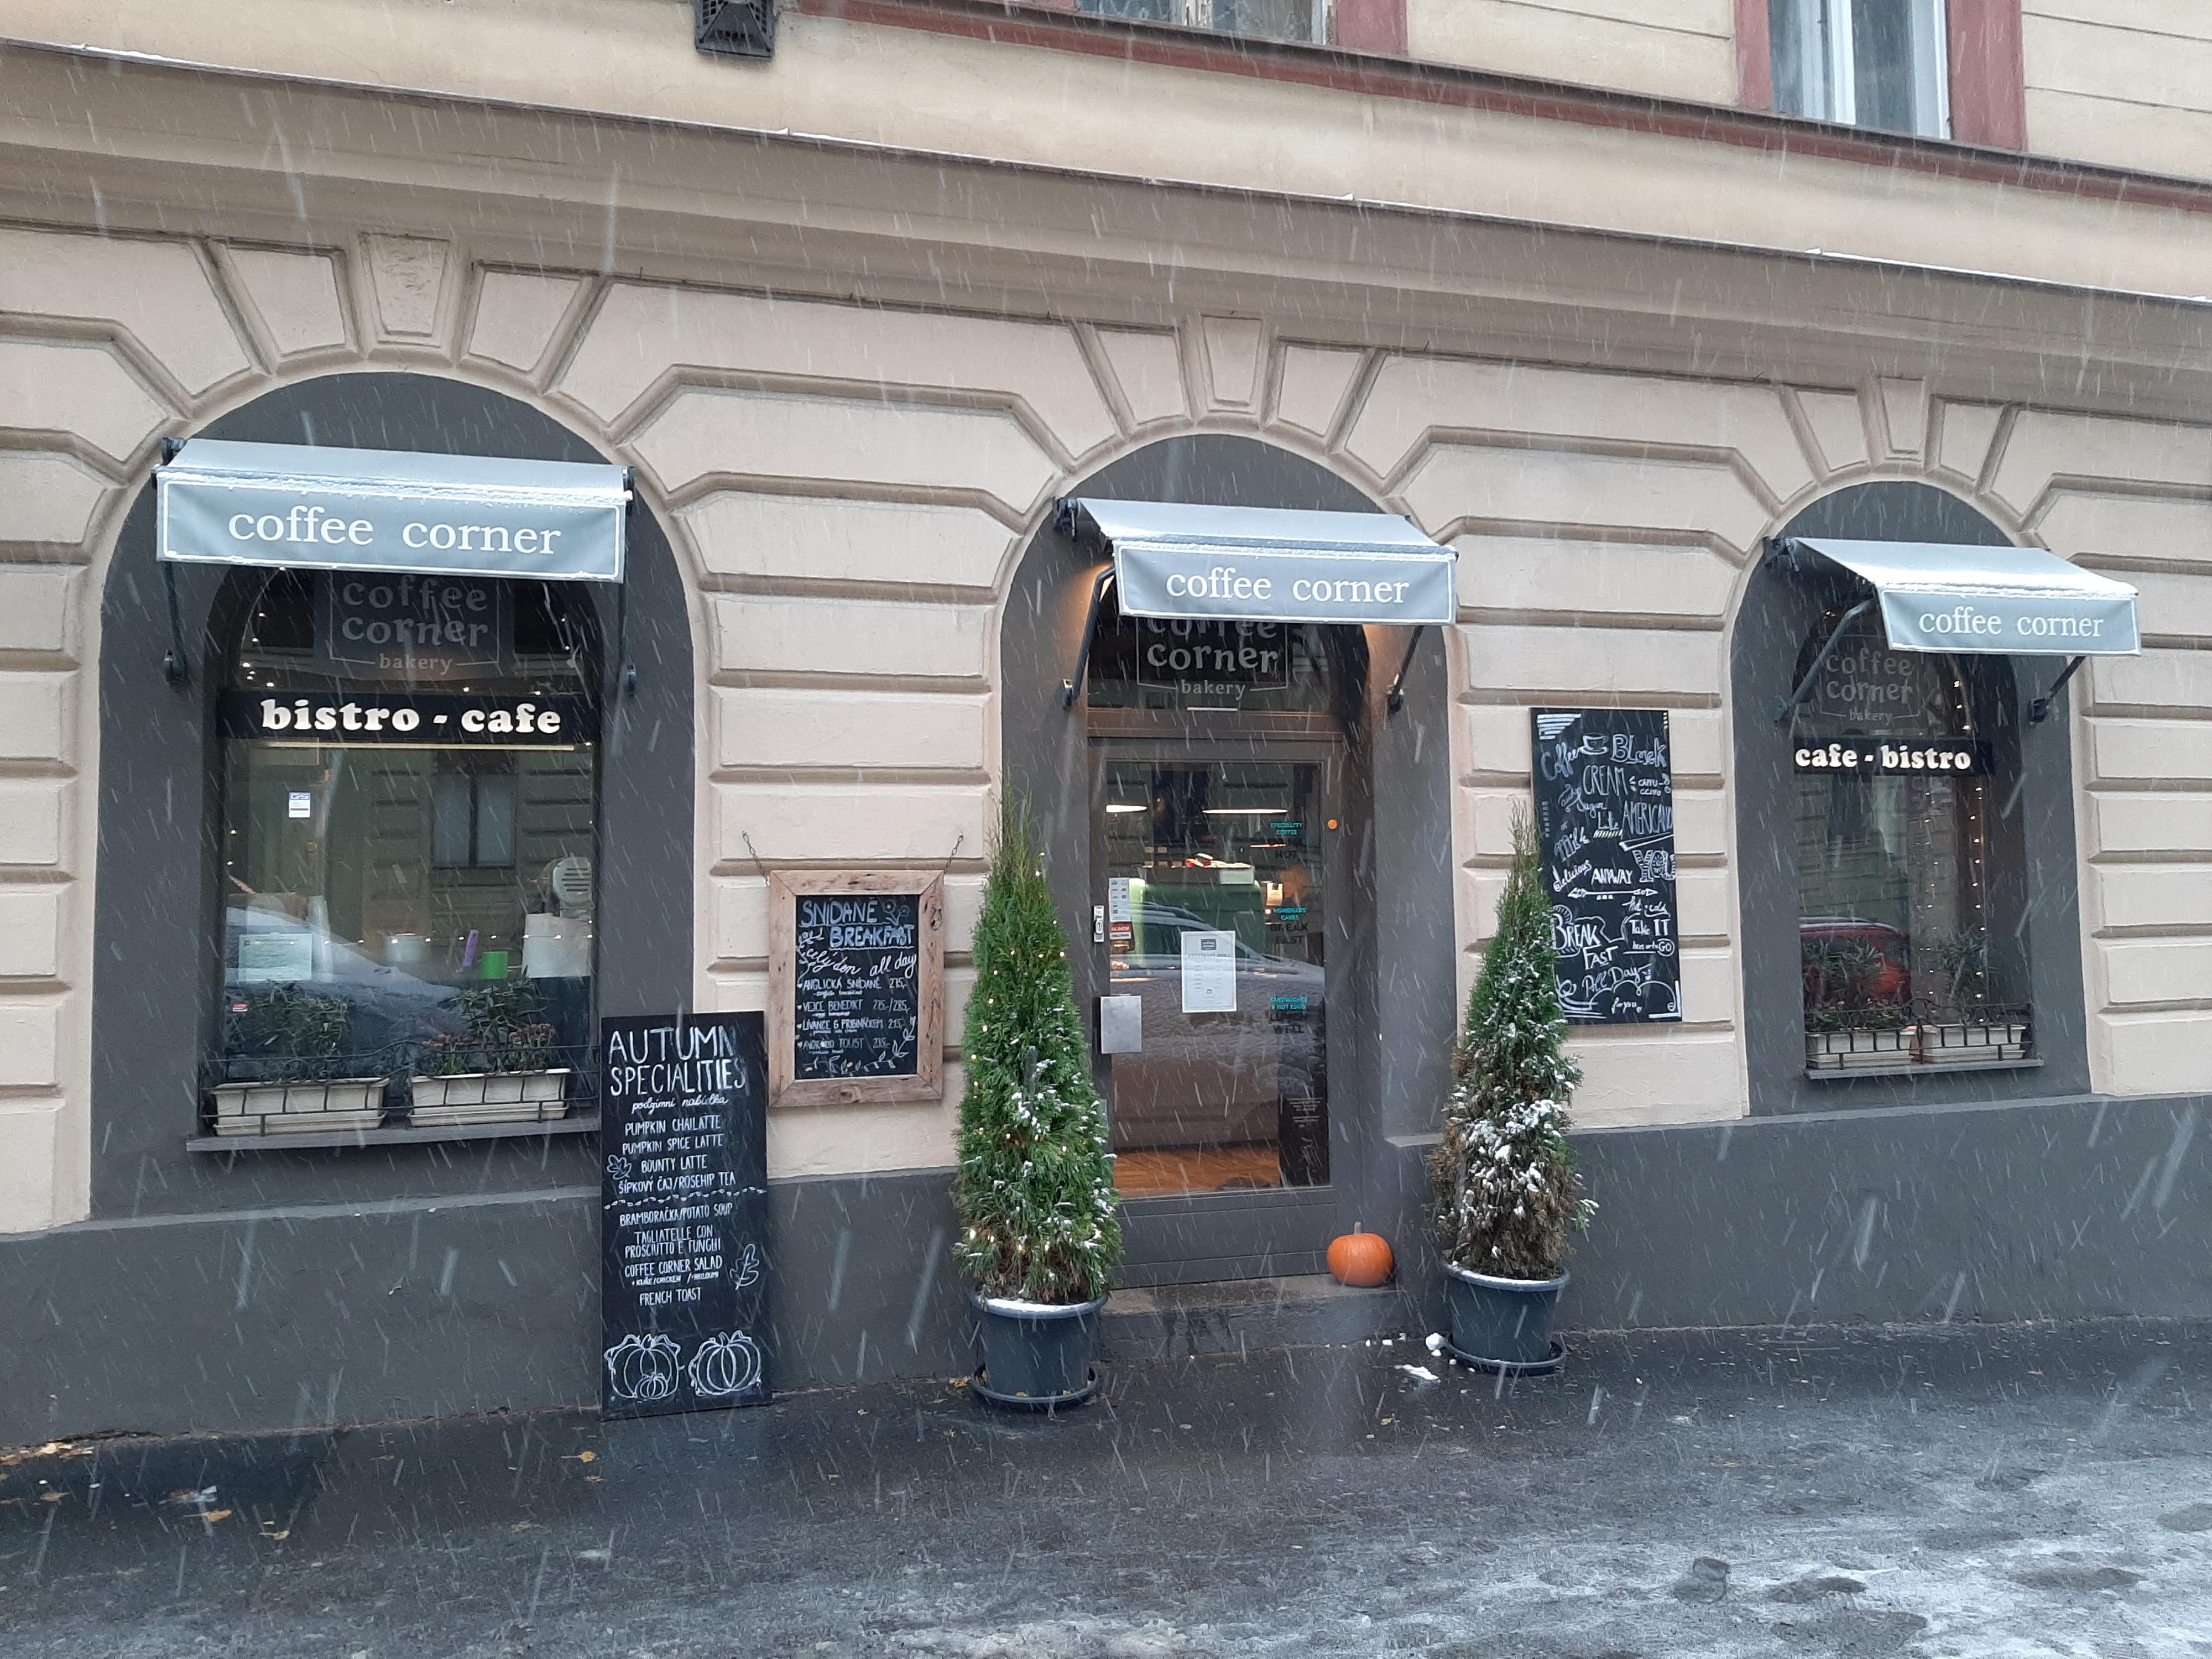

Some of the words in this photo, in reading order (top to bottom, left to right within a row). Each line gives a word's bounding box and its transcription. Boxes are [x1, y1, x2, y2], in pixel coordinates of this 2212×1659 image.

[228, 505, 374, 545] coffee
[402, 521, 561, 554] corner
[343, 575, 487, 611] coffee
[1166, 567, 1272, 600] coffee
[1292, 578, 1410, 603] corner
[342, 617, 488, 647] corner
[1919, 607, 2001, 635] coffee
[2017, 615, 2104, 638] corner
[379, 654, 452, 675] bakery
[1147, 644, 1277, 673] corner
[1827, 648, 1912, 676] coffee
[1181, 680, 1245, 701] bakery
[1827, 681, 1912, 704] corner
[260, 699, 419, 732] bistro
[461, 703, 561, 734] cafe
[1795, 744, 1858, 768] cafe
[1881, 746, 1971, 770] bistro
[1583, 765, 1628, 796] CREAM
[830, 924, 915, 947] BREAKFAST
[895, 952, 916, 979] day
[609, 1025, 734, 1064] AUTUMN
[610, 1058, 747, 1096] SPECIALITIES
[625, 1120, 666, 1136] PUMPKIN
[622, 1141, 662, 1155] PUMPKIN
[667, 1136, 691, 1151] SPICE
[695, 1134, 724, 1149] LATTE
[641, 1157, 676, 1173] BOUNTY
[681, 1154, 707, 1170] LATTE
[718, 1171, 736, 1186] TEA
[713, 1203, 733, 1216] SOUP
[634, 1226, 691, 1244] TAGLIATELLE
[696, 1224, 713, 1239] CON
[625, 1242, 675, 1259] PROSCIUTTO
[624, 1262, 656, 1277] COFFEE
[658, 1259, 691, 1274] CORNER
[694, 1255, 723, 1271] SALAD
[639, 1290, 672, 1306] FRENCH
[676, 1287, 702, 1301] TOAST
